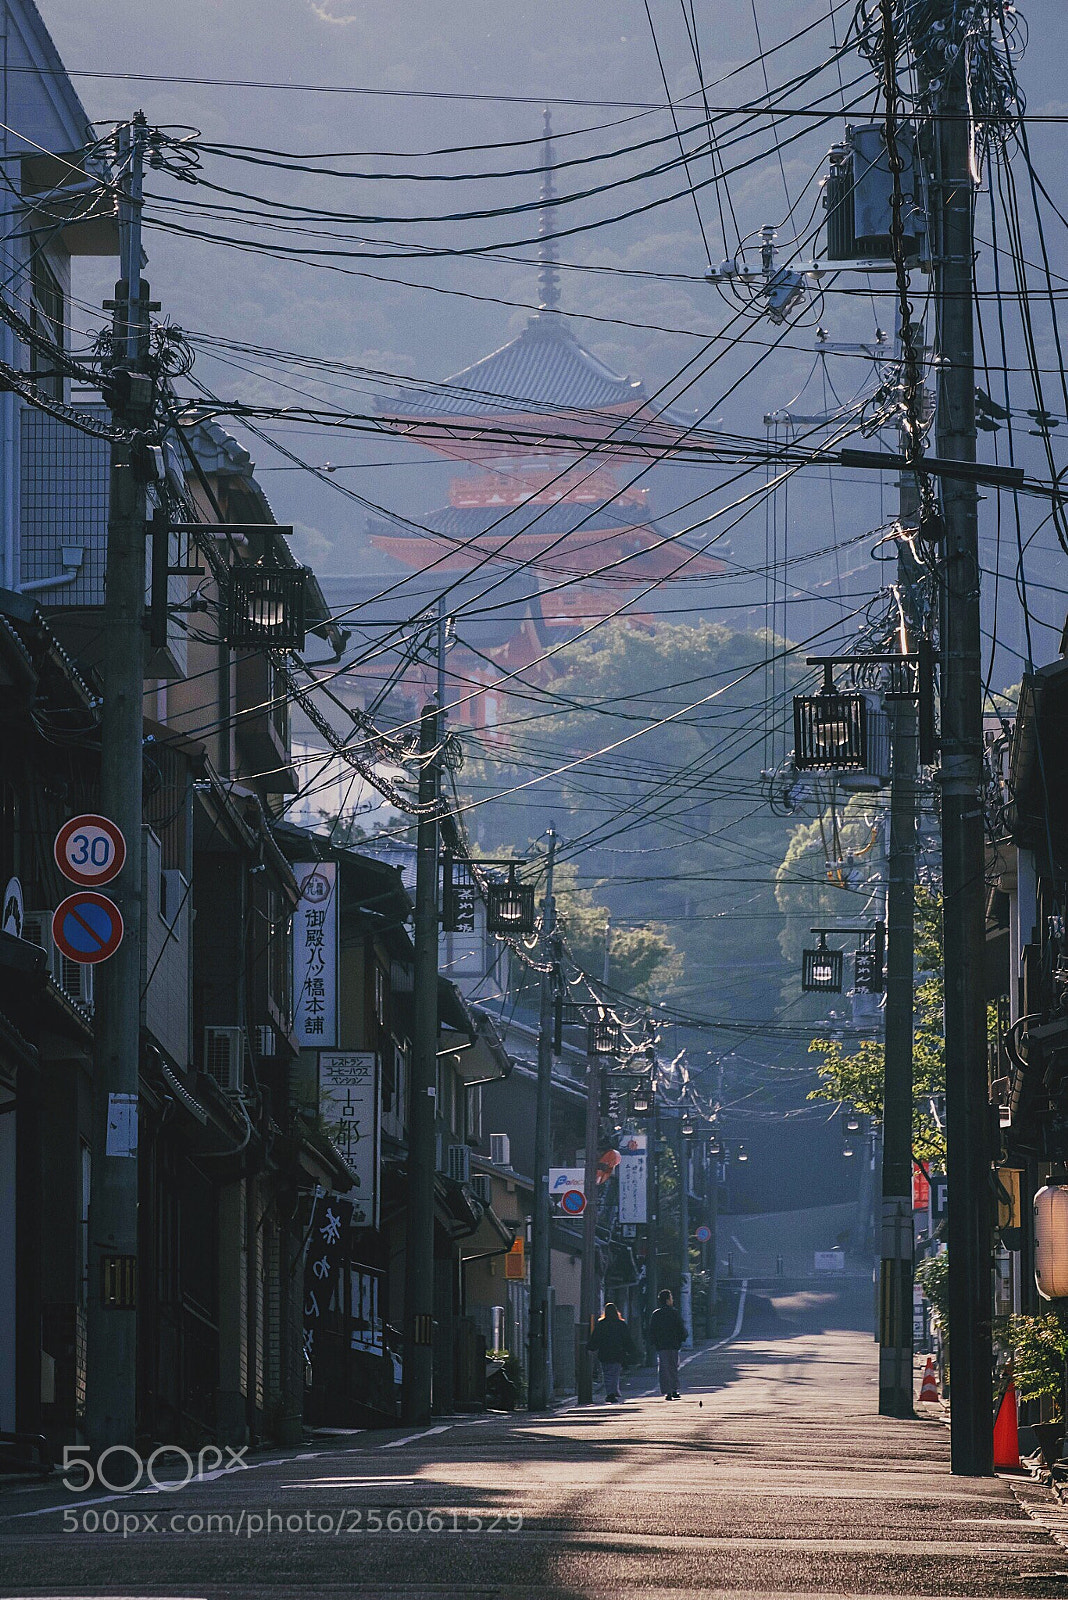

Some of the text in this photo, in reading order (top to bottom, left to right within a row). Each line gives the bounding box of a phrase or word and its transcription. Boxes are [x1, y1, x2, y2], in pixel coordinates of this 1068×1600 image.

[71, 835, 110, 867] 30
[456, 888, 474, 933] 茶わん坂
[331, 1058, 364, 1067] レストラン
[326, 1067, 369, 1076] コーヒーハウス
[331, 1077, 363, 1085] ペンション
